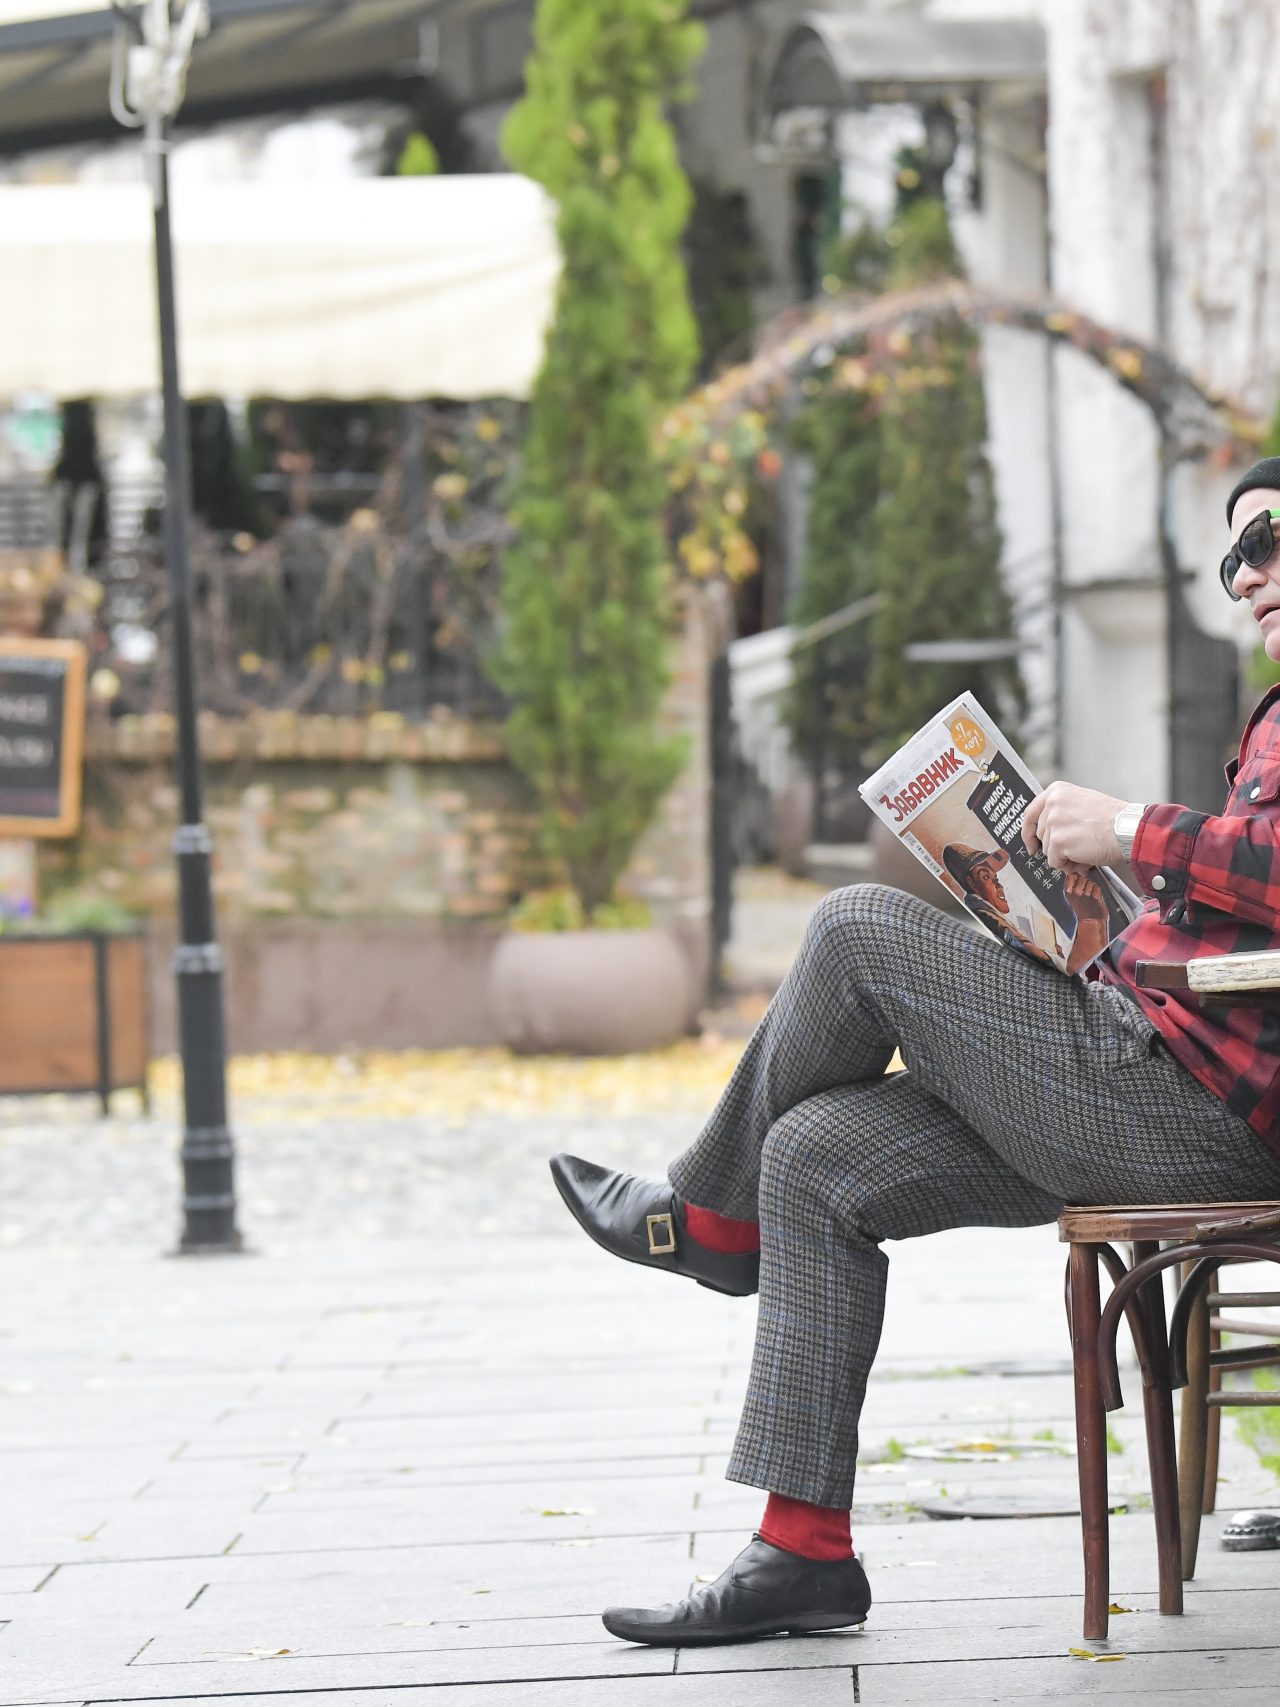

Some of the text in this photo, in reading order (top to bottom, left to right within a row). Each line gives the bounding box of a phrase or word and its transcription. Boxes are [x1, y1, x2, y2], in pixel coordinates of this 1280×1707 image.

[879, 747, 965, 822] ЗАБАВНИК
[982, 780, 1006, 815] ПРИЛОГ
[988, 788, 1015, 822] ЧИТАЊУ
[993, 794, 1028, 837] КИНЕСКИХ
